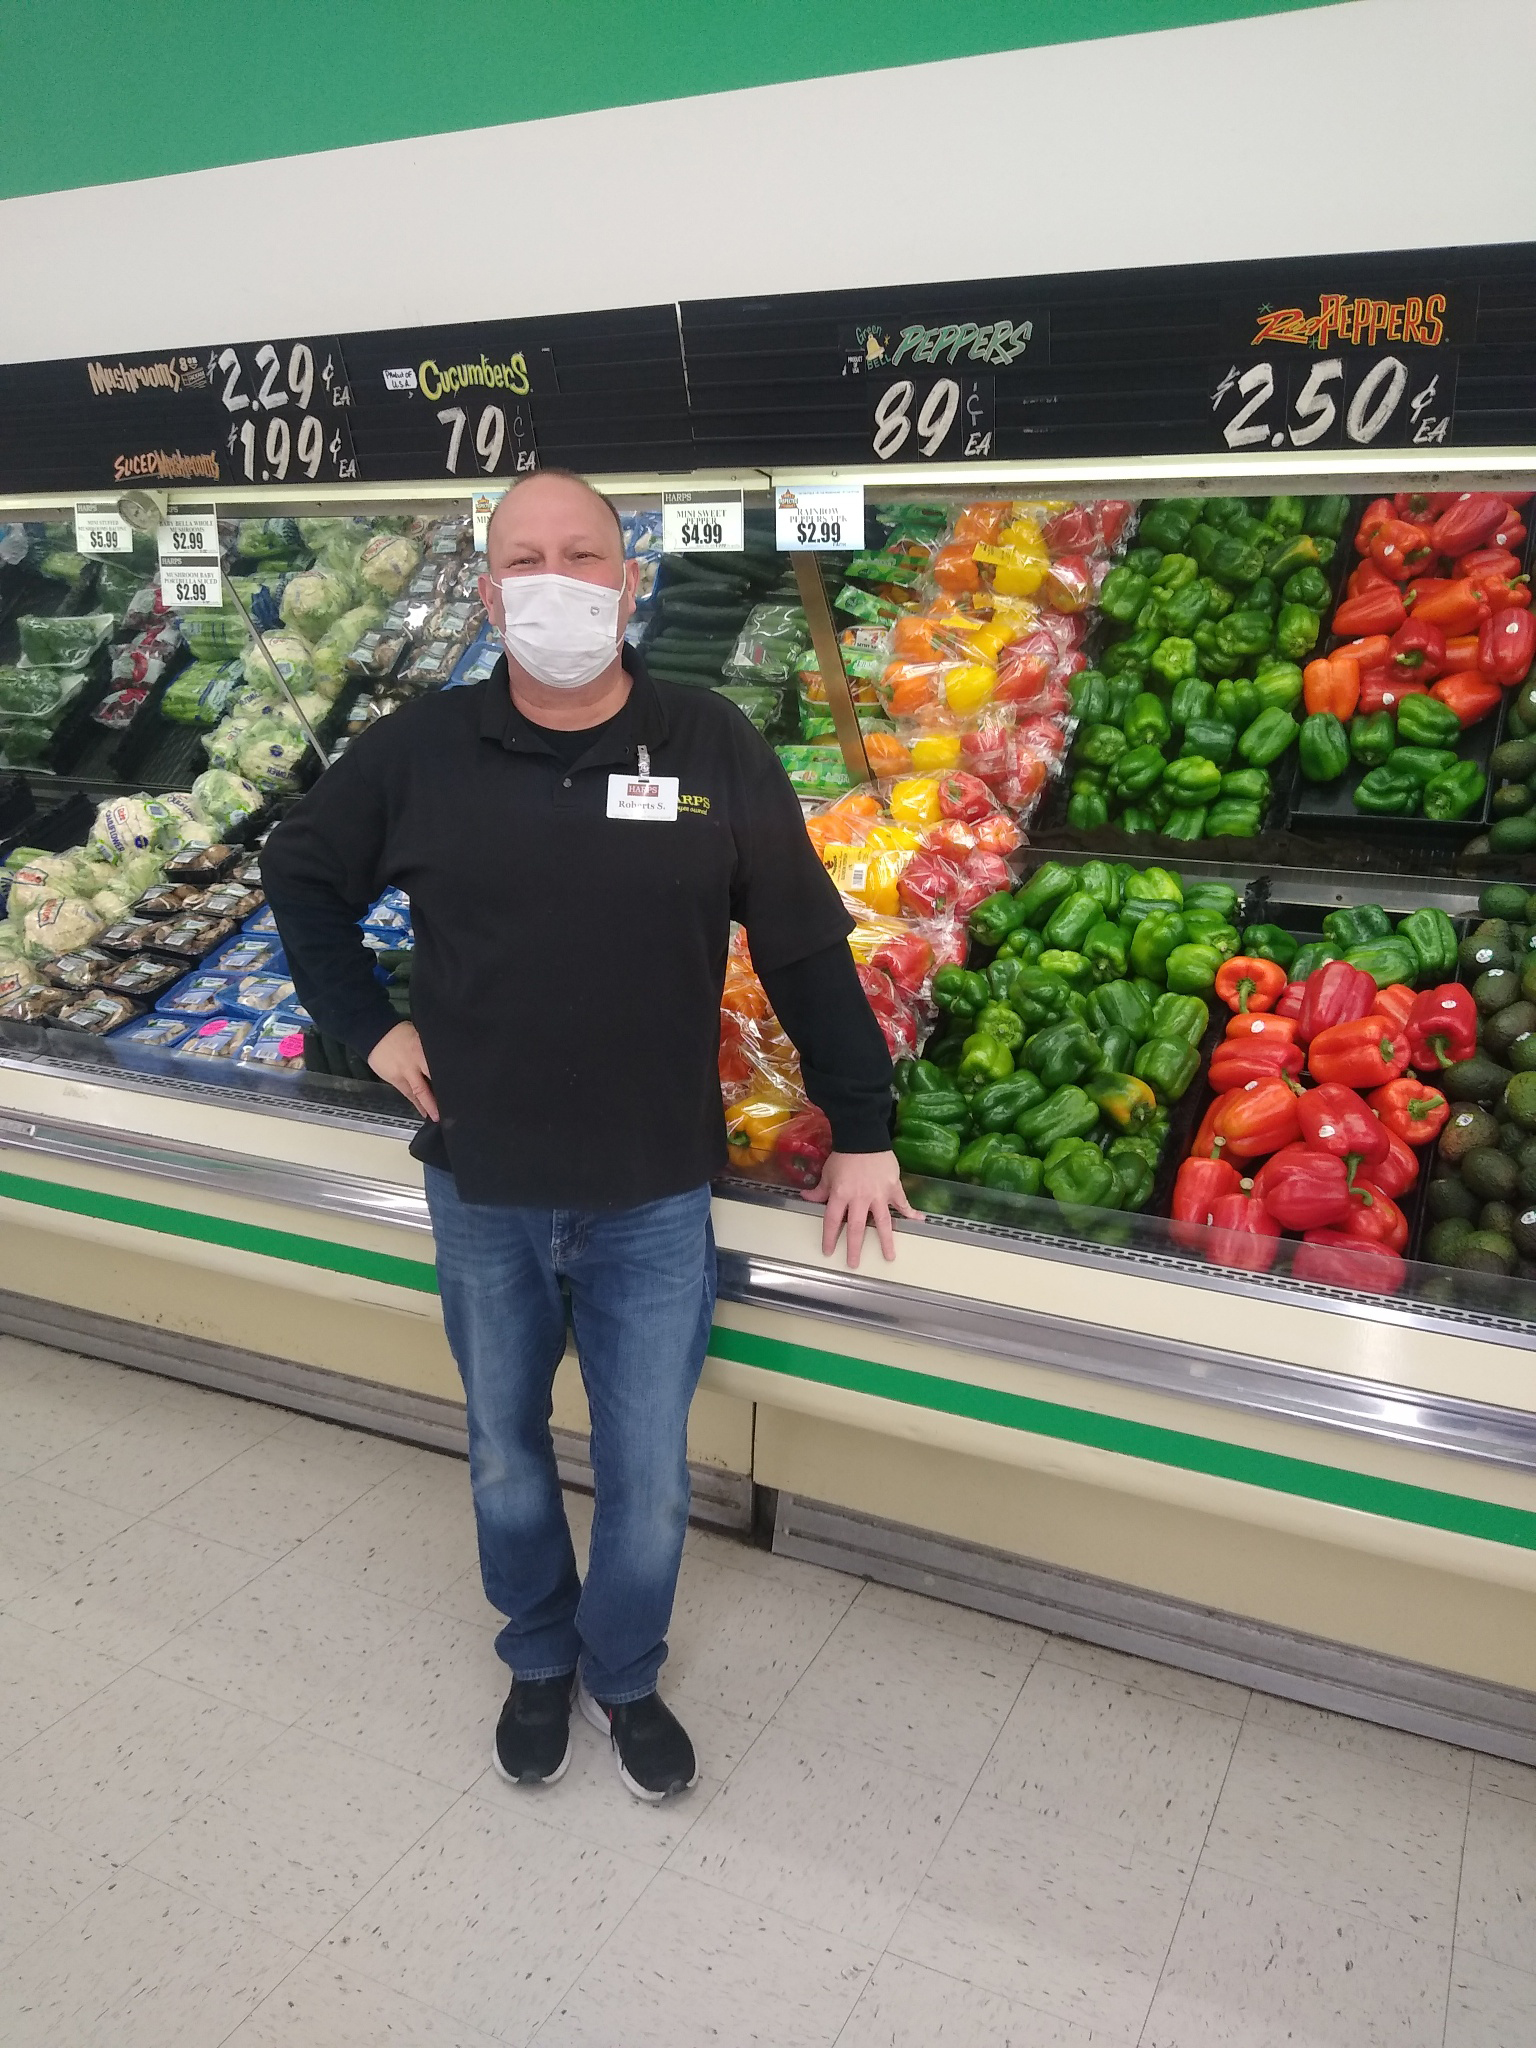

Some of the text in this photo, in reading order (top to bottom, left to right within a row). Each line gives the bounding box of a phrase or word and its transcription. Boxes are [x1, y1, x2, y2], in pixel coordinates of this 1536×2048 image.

[1318, 293, 1446, 349] PEPPERS
[855, 325, 882, 345] Green
[892, 319, 1033, 366] PEPPERS
[867, 354, 891, 370] BELL
[332, 386, 350, 406] EA
[873, 377, 960, 460] 89
[437, 404, 505, 474] 79
[1412, 417, 1450, 444] EA
[964, 431, 992, 456] EA
[339, 458, 357, 478] EA
[516, 450, 536, 472] EA
[665, 493, 692, 502] HARPS
[90, 530, 118, 549] $5.99
[172, 531, 204, 551] $2.99
[681, 523, 722, 547] $4.99
[797, 521, 841, 546] $2.99
[161, 557, 182, 565] HARPS
[176, 583, 206, 602] $2.99
